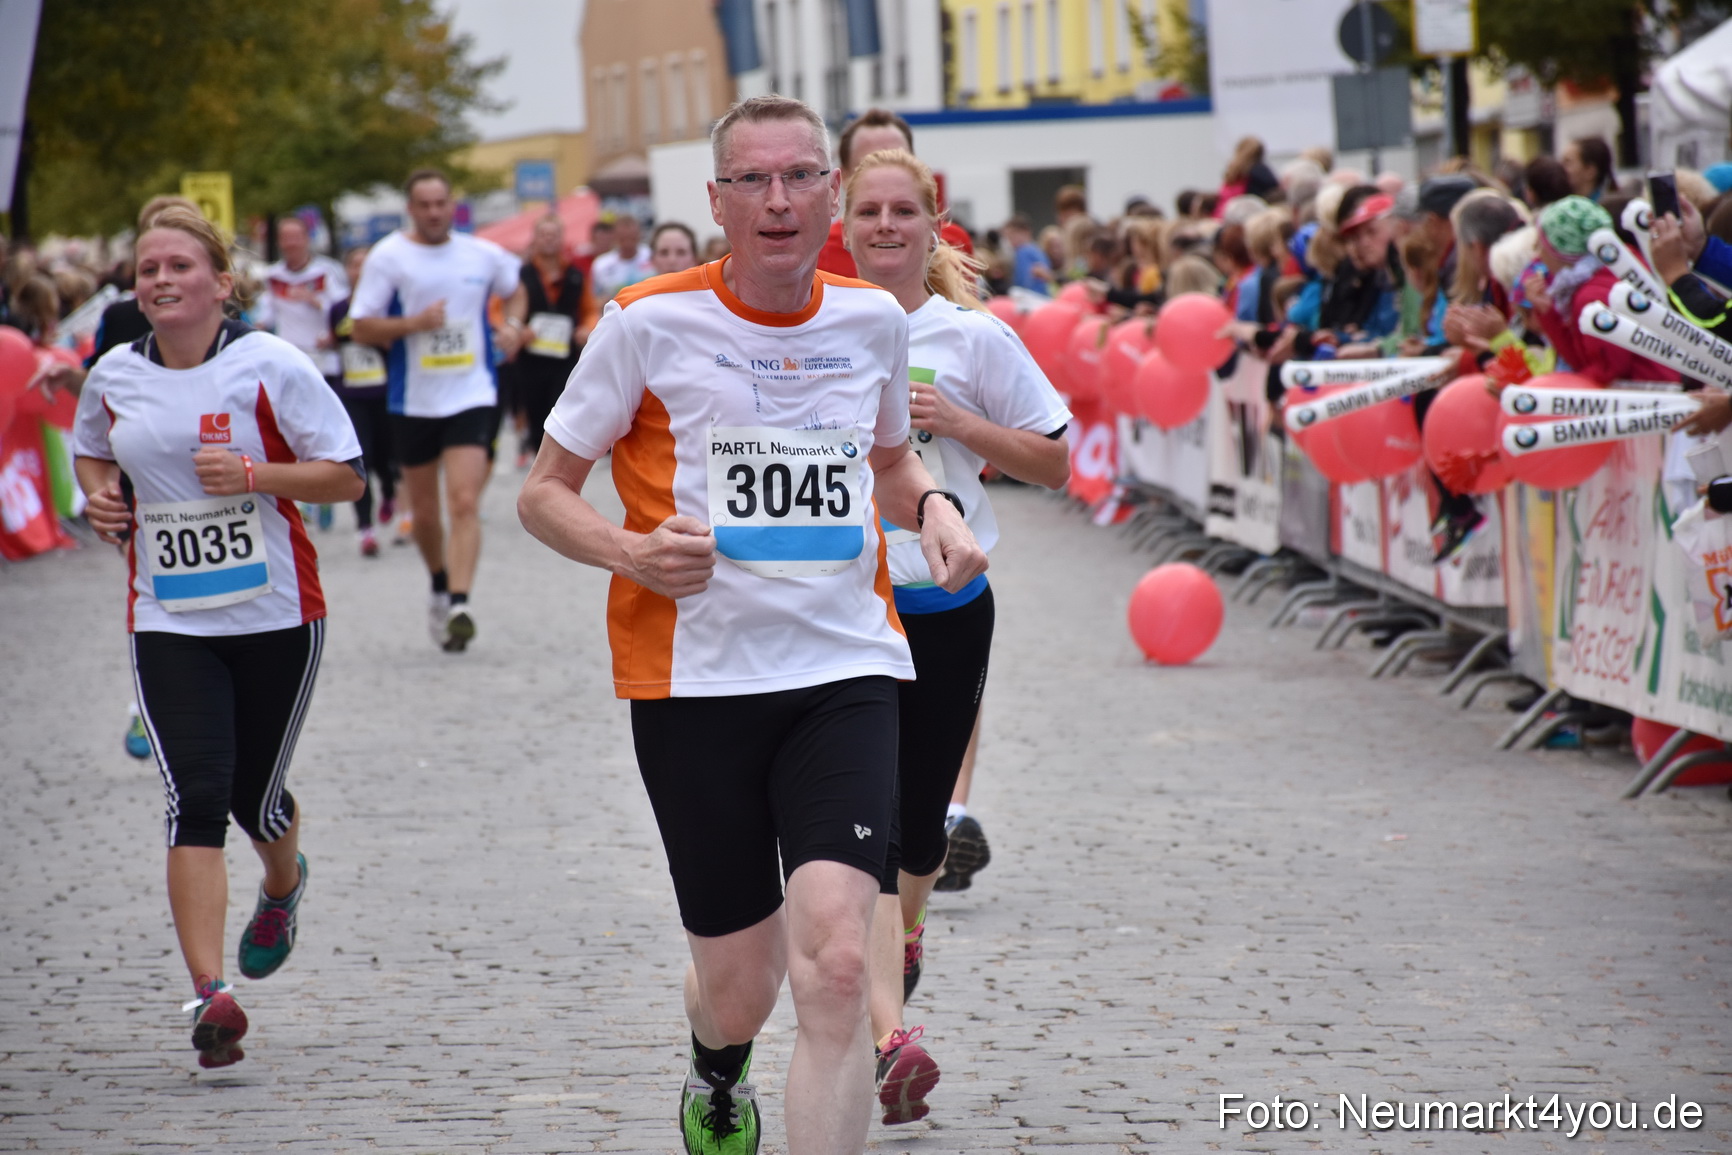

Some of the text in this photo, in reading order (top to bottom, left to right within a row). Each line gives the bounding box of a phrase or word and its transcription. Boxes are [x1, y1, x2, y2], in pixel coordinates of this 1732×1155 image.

[750, 359, 780, 371] ING
[804, 363, 853, 371] LUXEMBOURG
[757, 373, 801, 381] LUXEMBOURG
[753, 383, 761, 413] FINISHER
[202, 432, 230, 442] DKMS
[1552, 417, 1607, 443] BMW
[711, 441, 837, 456] PARTL Neumarkt
[726, 463, 851, 519] 3045
[144, 505, 237, 524] PARTL Neumarkt
[156, 520, 253, 569] 3035
